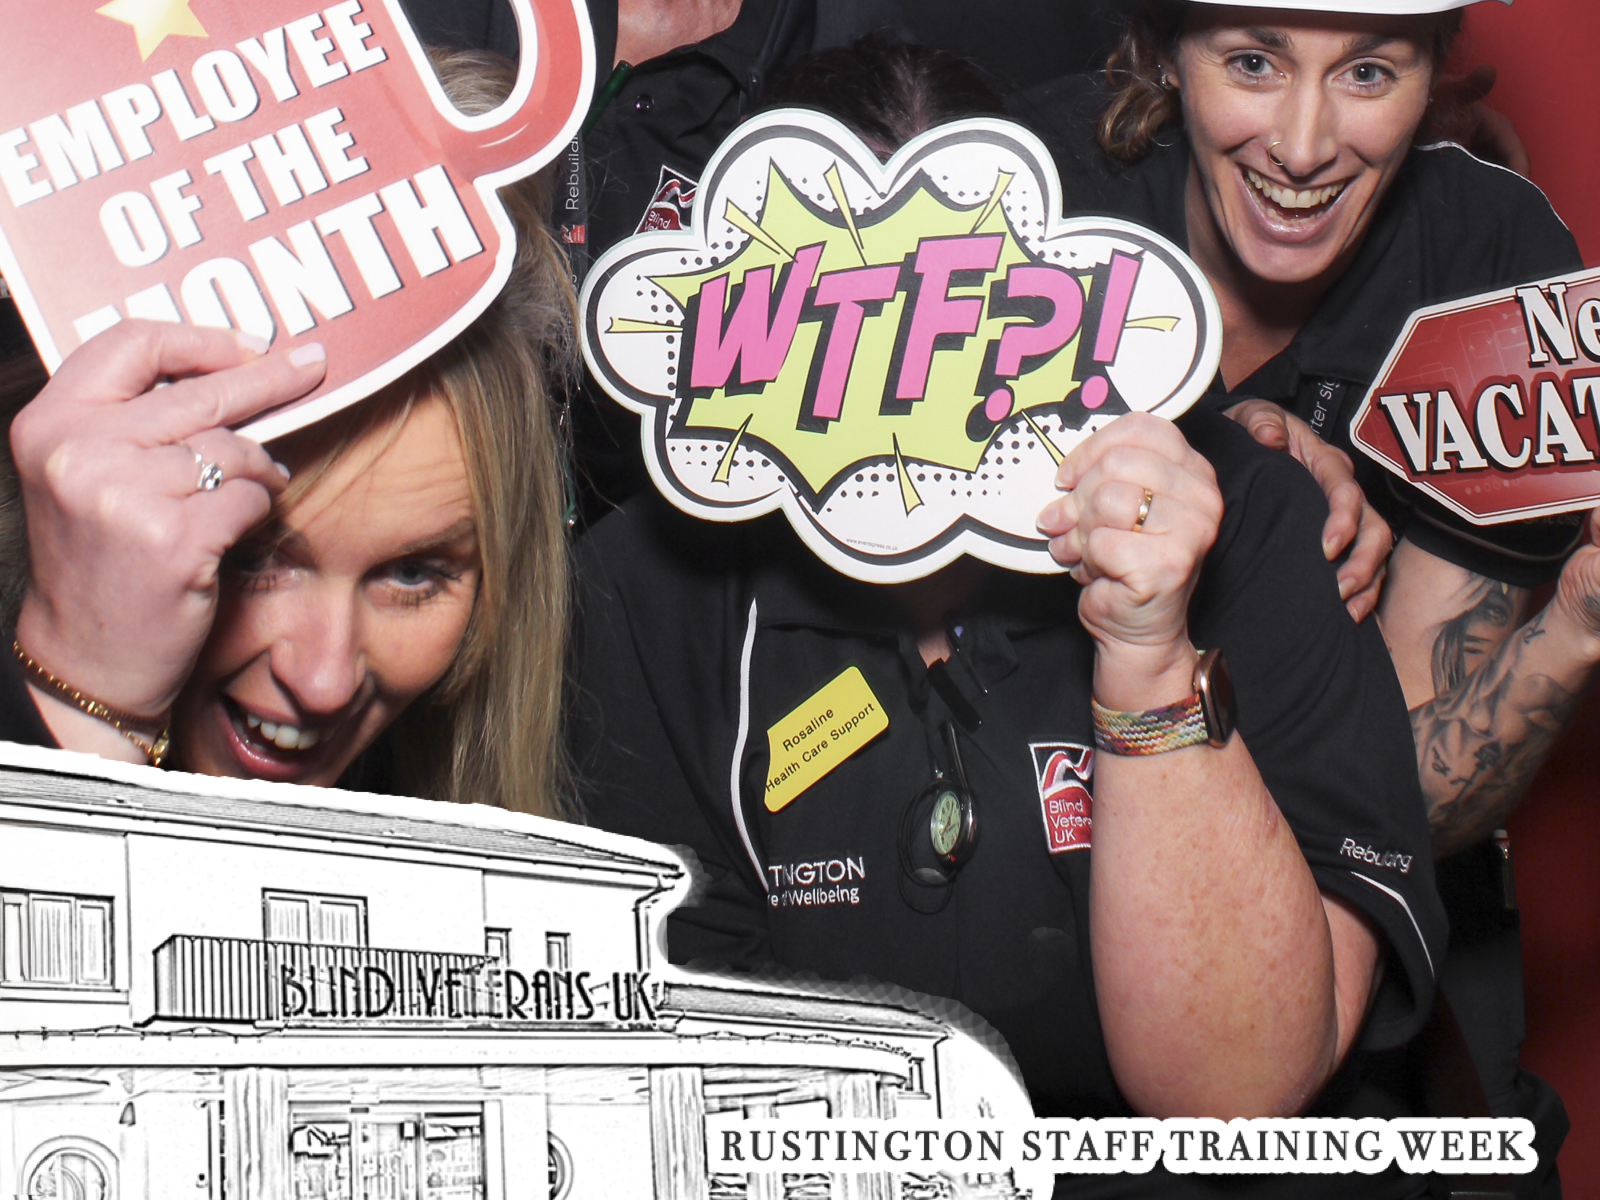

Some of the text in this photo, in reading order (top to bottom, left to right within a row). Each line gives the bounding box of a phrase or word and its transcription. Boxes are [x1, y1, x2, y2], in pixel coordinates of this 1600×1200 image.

[99, 107, 370, 268] OF THE
[686, 232, 1145, 424] WTF?!
[765, 702, 875, 792] Health Care Support
[782, 708, 834, 752] Rosaline
[1049, 798, 1084, 814] Blind
[1054, 828, 1076, 843] UK
